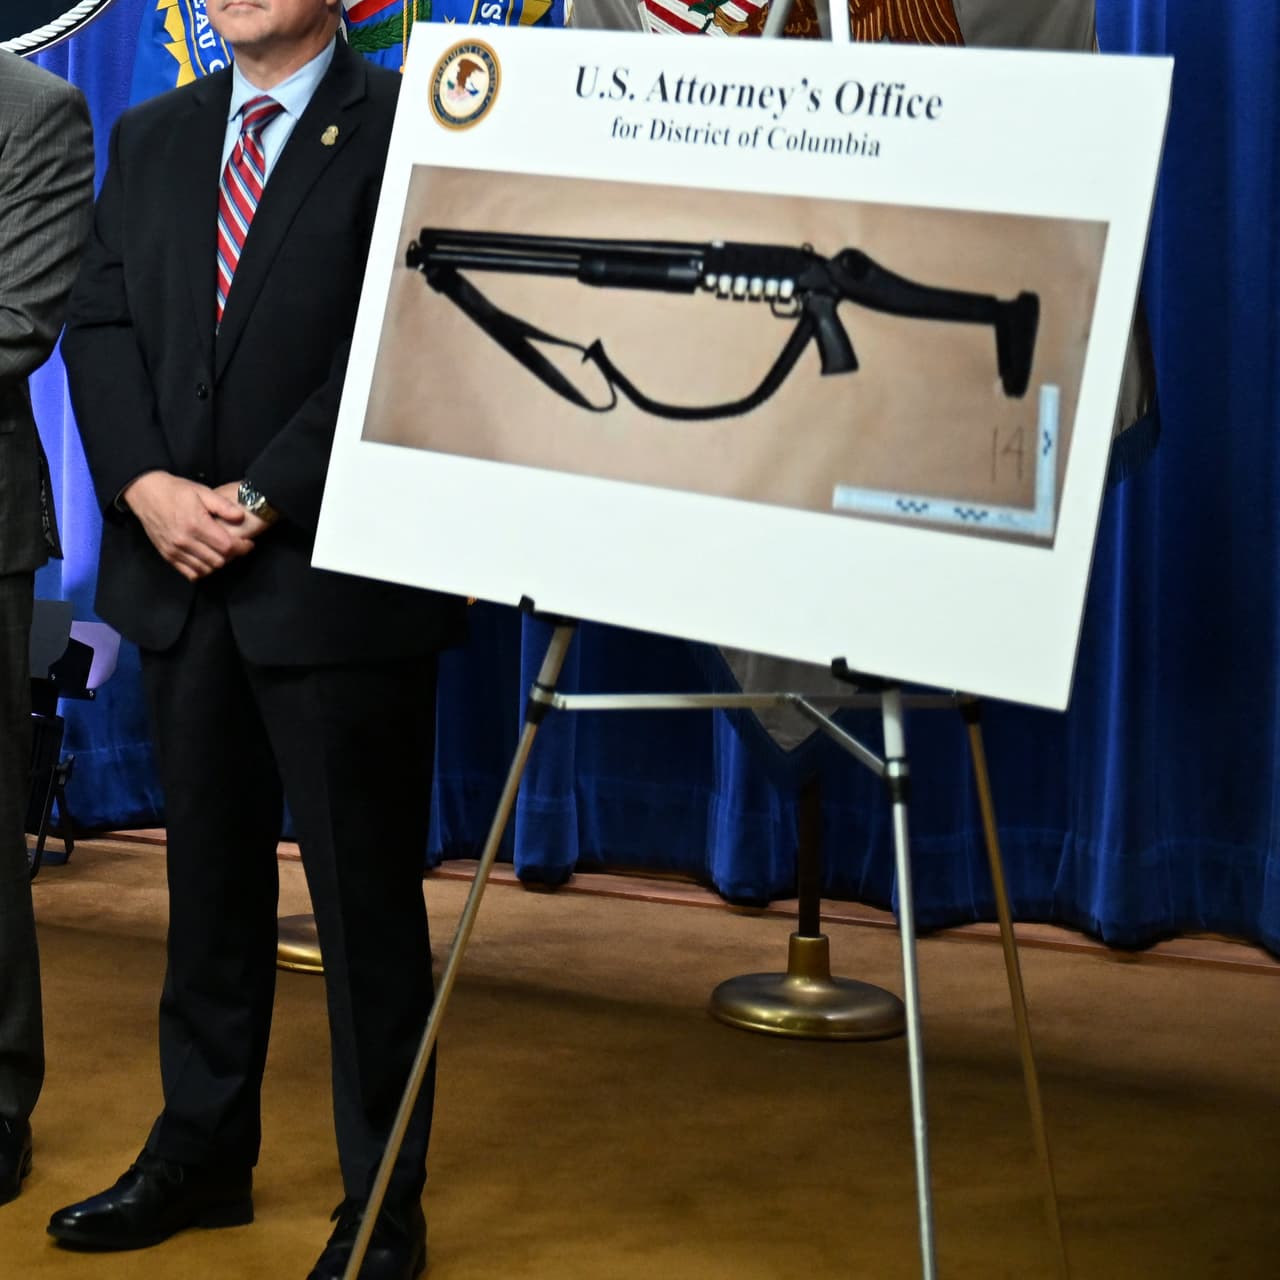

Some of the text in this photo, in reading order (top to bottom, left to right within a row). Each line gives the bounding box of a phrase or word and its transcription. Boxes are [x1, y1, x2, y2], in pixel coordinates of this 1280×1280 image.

[575, 65, 943, 120] U.S. Attorney's Office
[611, 116, 881, 157] for District of Columbia
[991, 426, 1024, 483] 14
